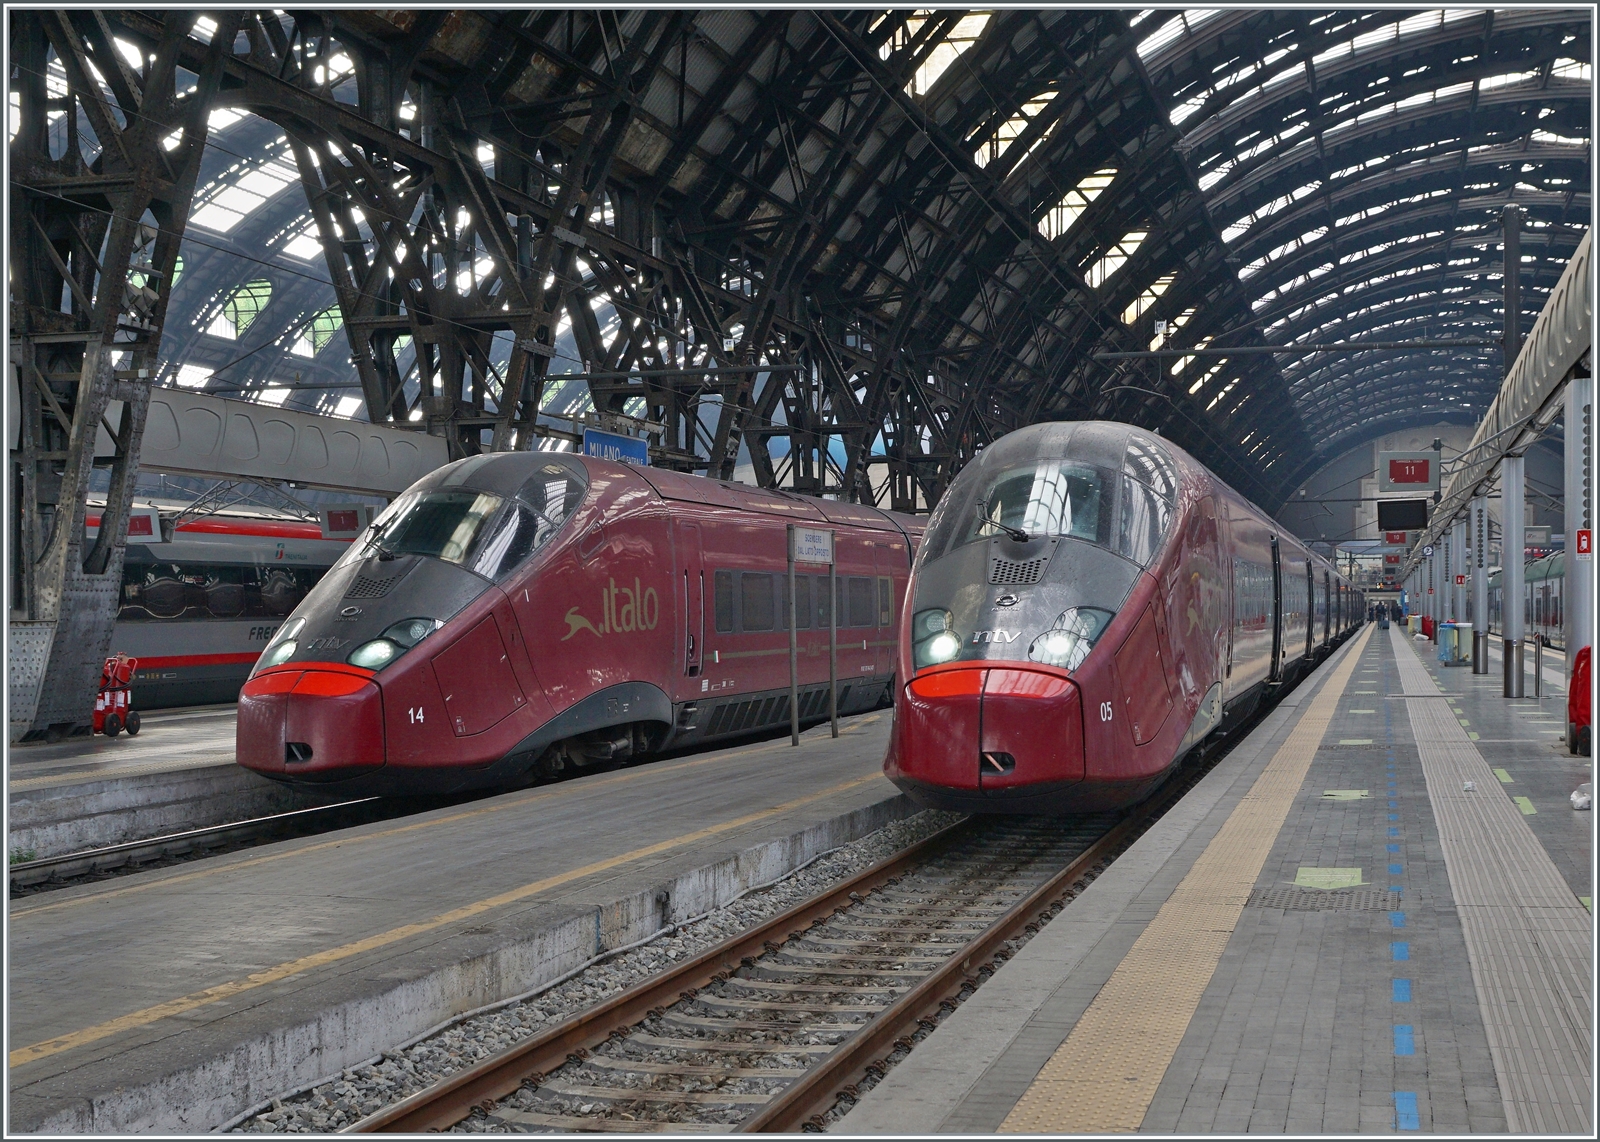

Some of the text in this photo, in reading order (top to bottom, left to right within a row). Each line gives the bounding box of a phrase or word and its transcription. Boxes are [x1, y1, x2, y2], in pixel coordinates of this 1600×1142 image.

[589, 441, 644, 465] MILANO ENTRALE
[1405, 466, 1415, 475] 11
[341, 516, 345, 524] 1
[805, 534, 822, 543] SCENDERE
[797, 546, 805, 555] DAL
[805, 547, 814, 556] LATO
[307, 636, 351, 650] ntv
[972, 629, 1022, 643] ntv
[408, 706, 425, 724] 14
[1100, 701, 1112, 721] 05
